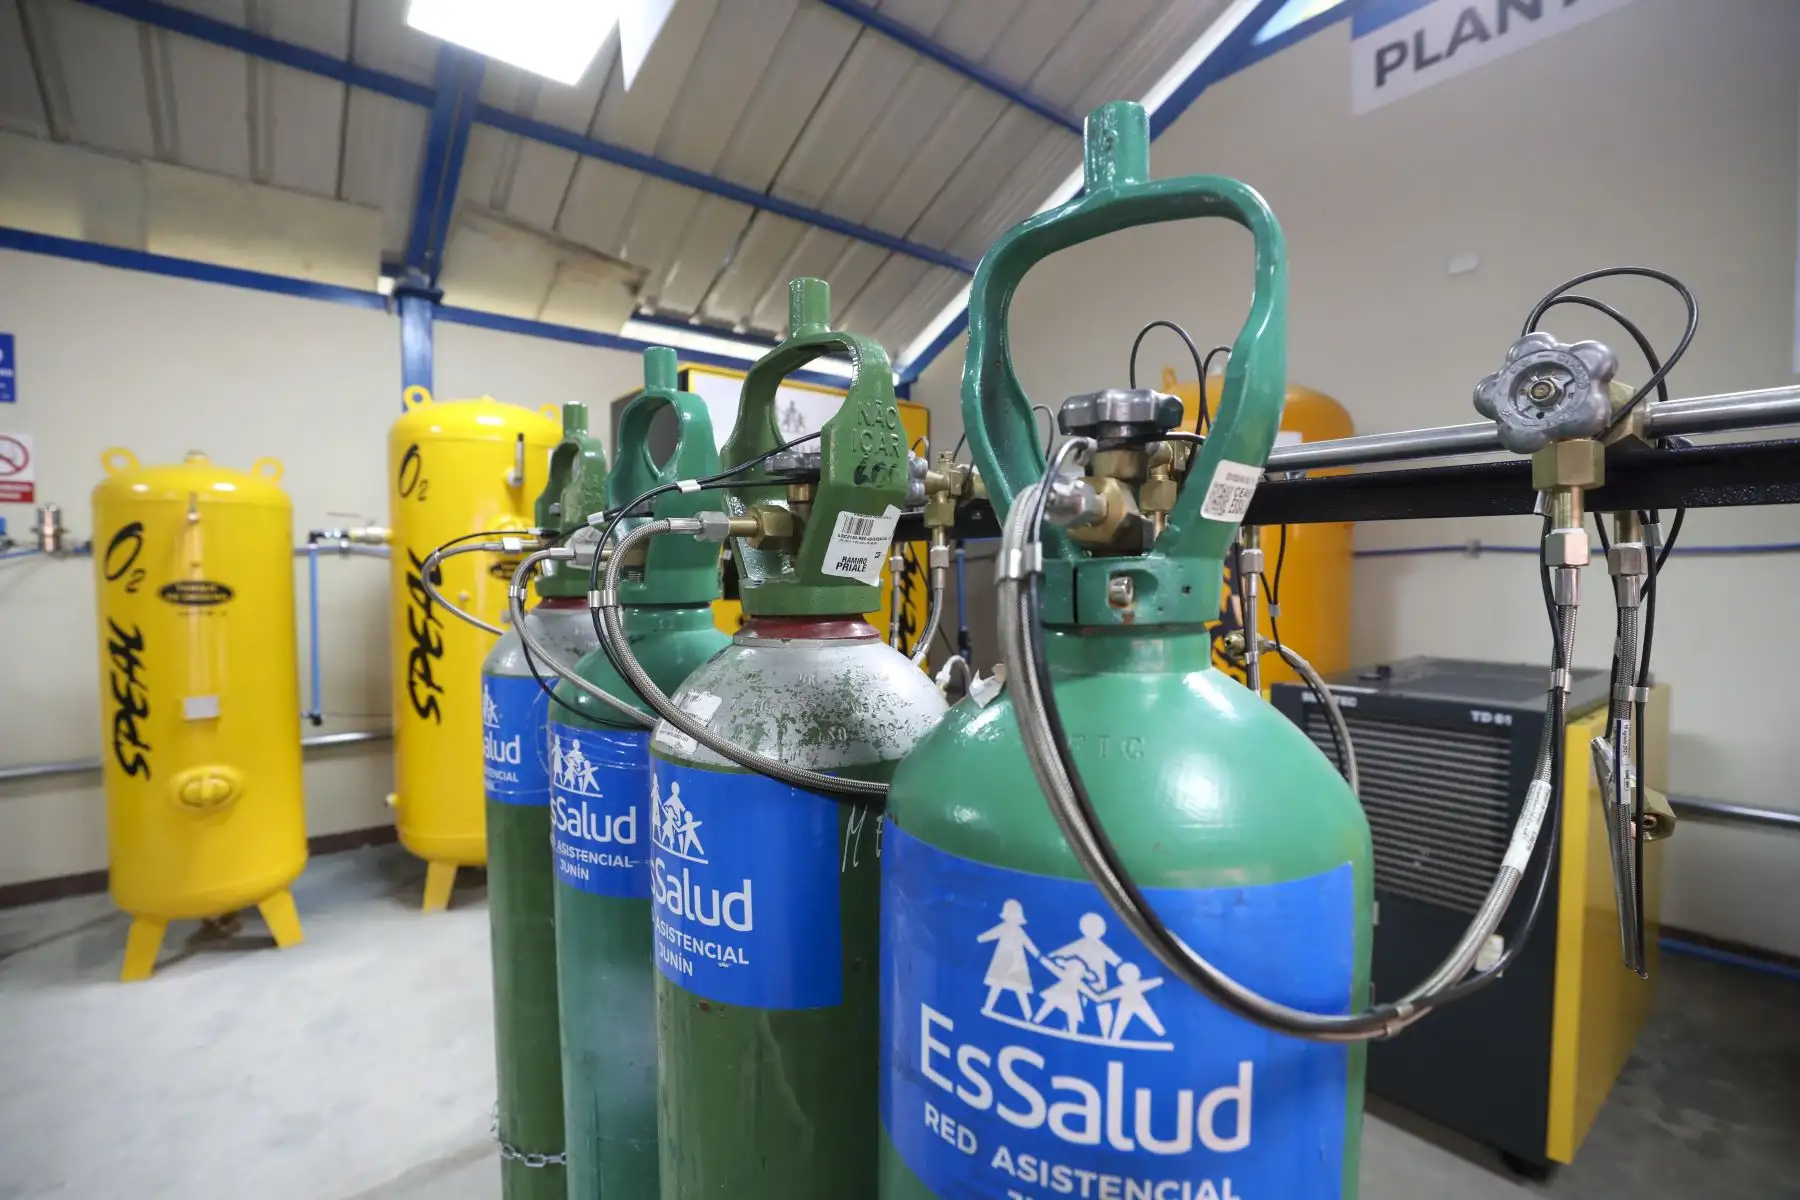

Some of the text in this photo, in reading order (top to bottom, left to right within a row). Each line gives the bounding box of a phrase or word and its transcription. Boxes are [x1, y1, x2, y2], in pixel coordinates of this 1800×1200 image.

[1374, 0, 1578, 89] PLAN
[835, 562, 868, 573] PRIALE
[841, 556, 868, 565] RAMIRO
[550, 796, 637, 845] sSalud
[650, 857, 753, 932] sSalud
[655, 915, 750, 965] ASISTENCIAL
[920, 1003, 1254, 1155] EsSalud
[924, 1101, 1241, 1200] RED ASISTENCIAL
